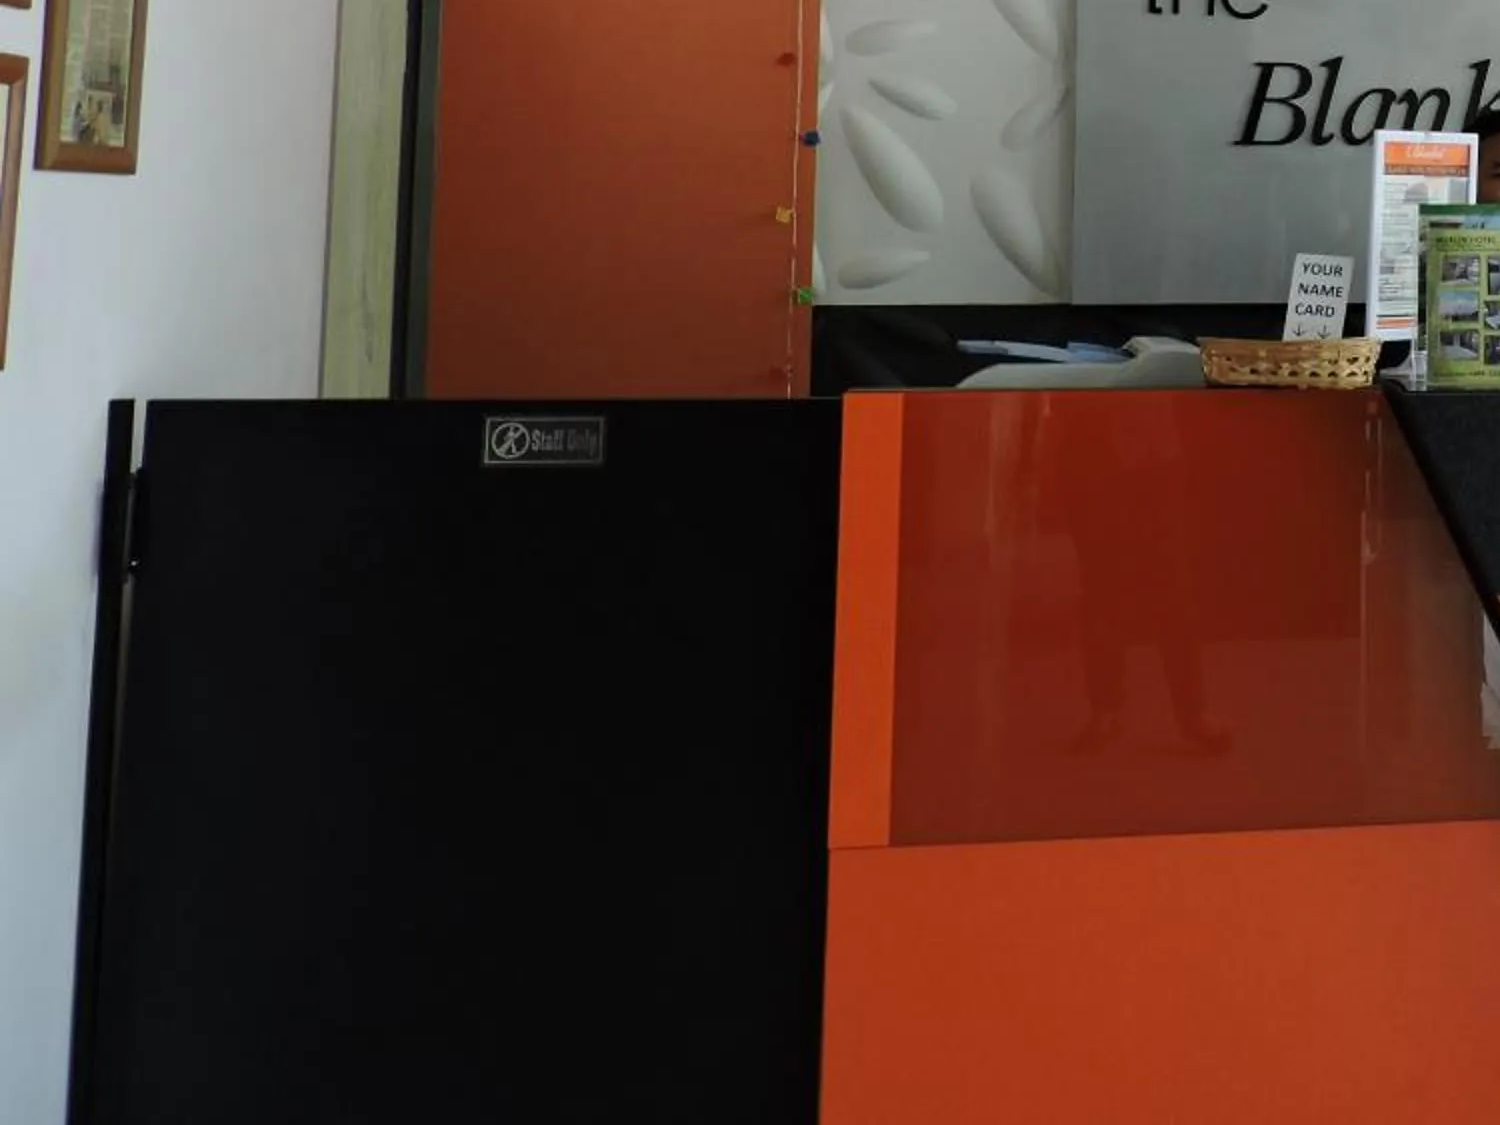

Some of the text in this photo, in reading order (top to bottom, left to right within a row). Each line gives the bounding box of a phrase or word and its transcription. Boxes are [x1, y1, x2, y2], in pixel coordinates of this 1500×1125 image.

[1302, 262, 1344, 278] YOUR
[1297, 281, 1345, 298] NAME
[1294, 301, 1336, 318] CARD
[531, 428, 599, 458] Staff Only
